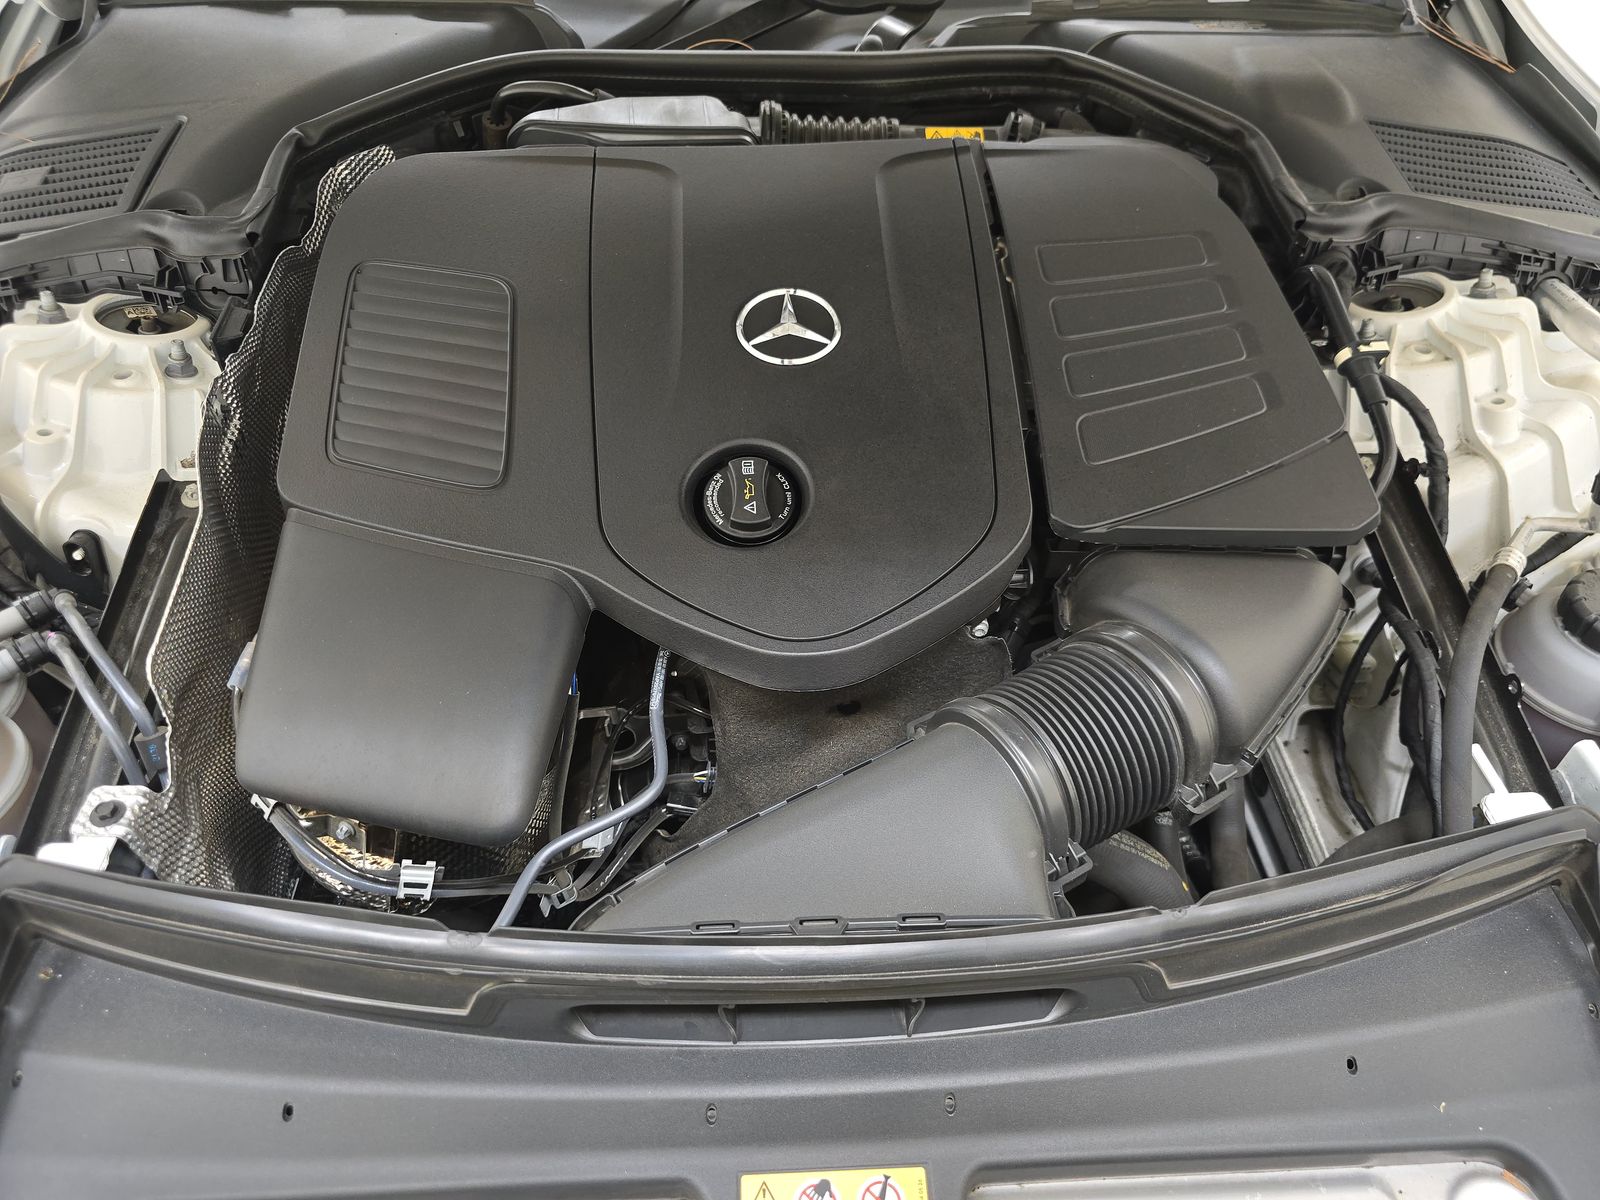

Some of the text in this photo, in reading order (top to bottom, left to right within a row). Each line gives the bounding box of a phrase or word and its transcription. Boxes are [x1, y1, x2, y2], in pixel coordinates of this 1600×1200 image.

[775, 472, 790, 490] CLICK
[706, 472, 724, 525] Mercedes-Benz Oil
[712, 478, 725, 517] recommended
[778, 506, 790, 520] Turn
